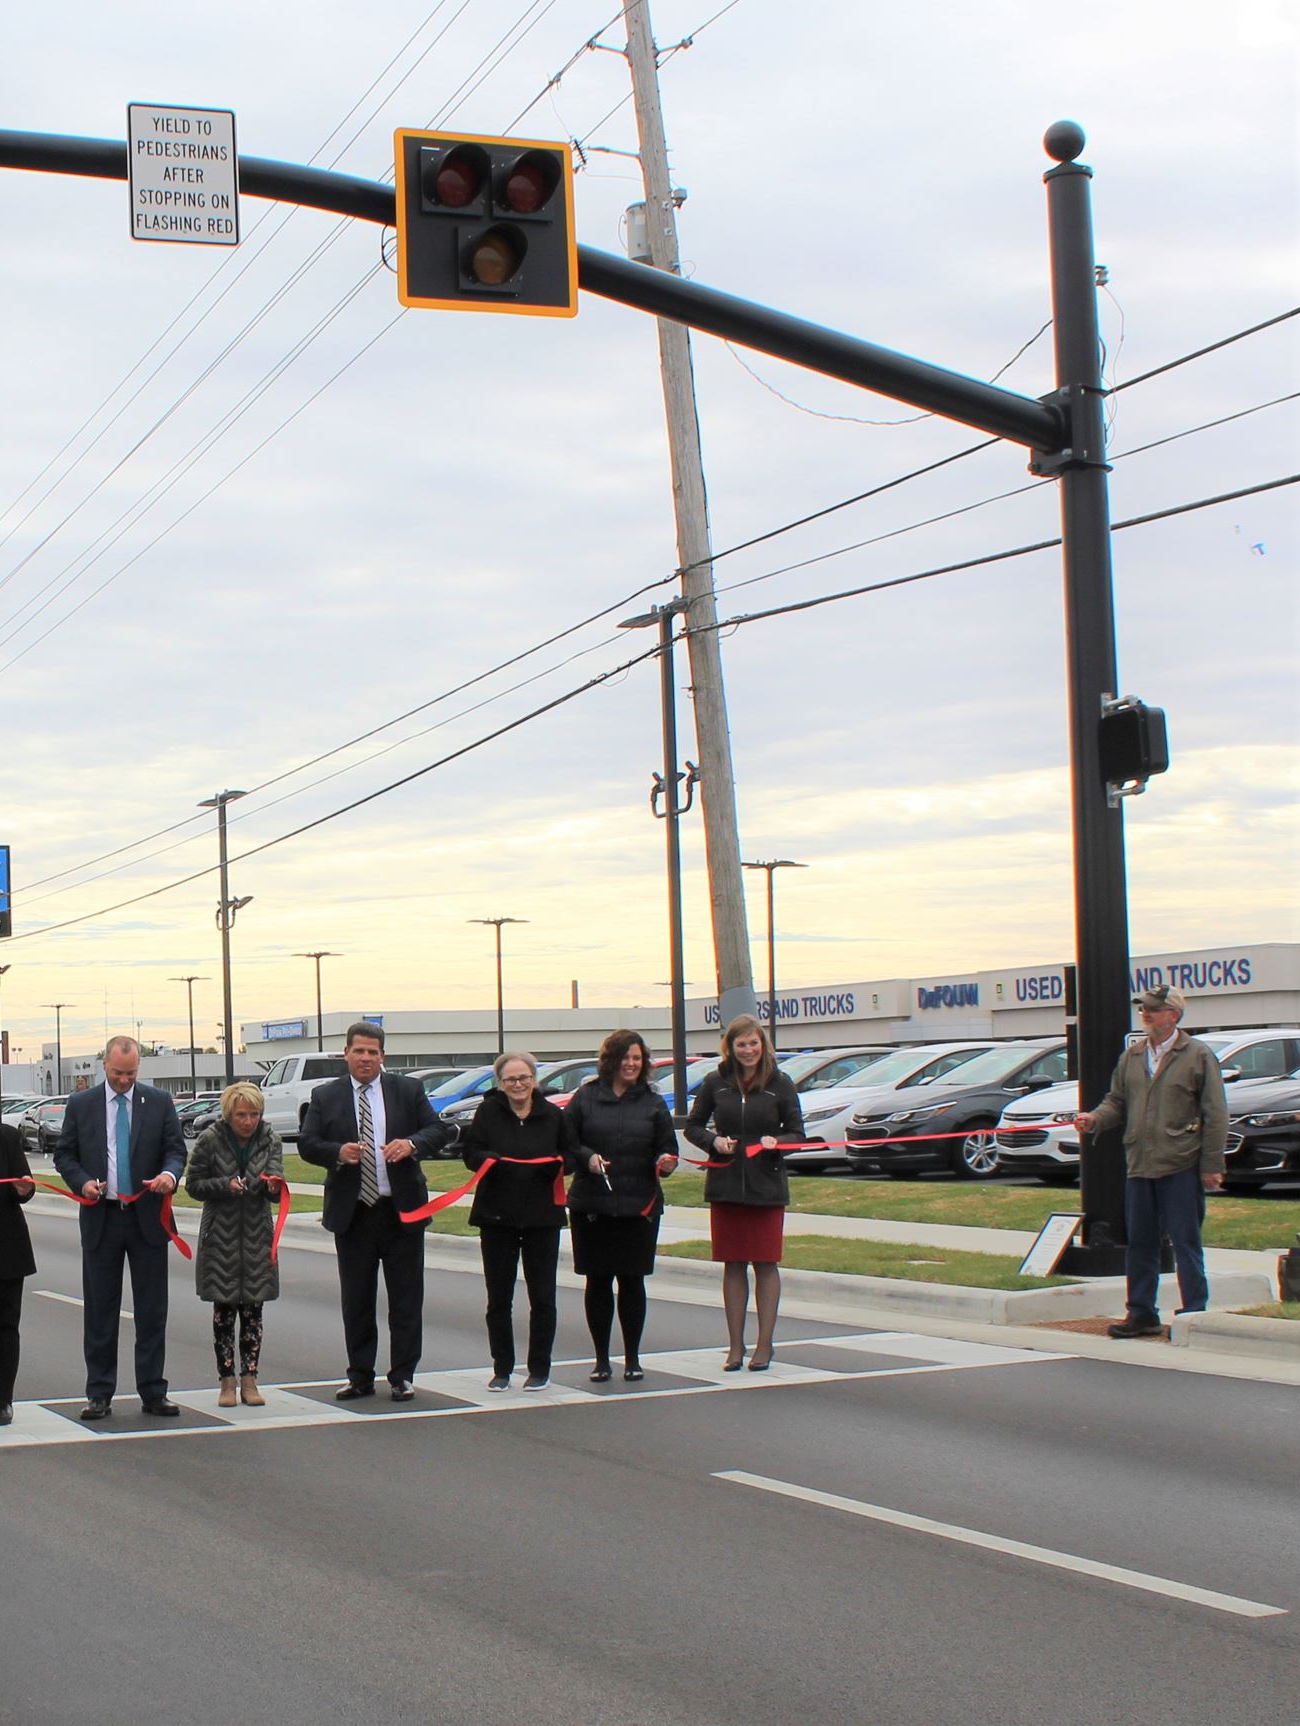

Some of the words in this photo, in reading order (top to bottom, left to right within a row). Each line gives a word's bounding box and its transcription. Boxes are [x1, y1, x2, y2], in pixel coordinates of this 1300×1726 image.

[152, 117, 190, 134] YIELD
[196, 120, 212, 135] TO
[137, 140, 228, 161] PEDESTRIANS
[163, 166, 204, 183] AFTER
[139, 189, 205, 208] STOPPING
[211, 194, 229, 209] ON
[136, 213, 202, 232] FLASHING
[207, 218, 233, 234] RED
[1016, 975, 1063, 1002] USED
[1167, 957, 1252, 990] TRUCKS
[704, 1005, 720, 1025] US
[774, 999, 799, 1019] AND
[801, 992, 855, 1017] TRUCKS
